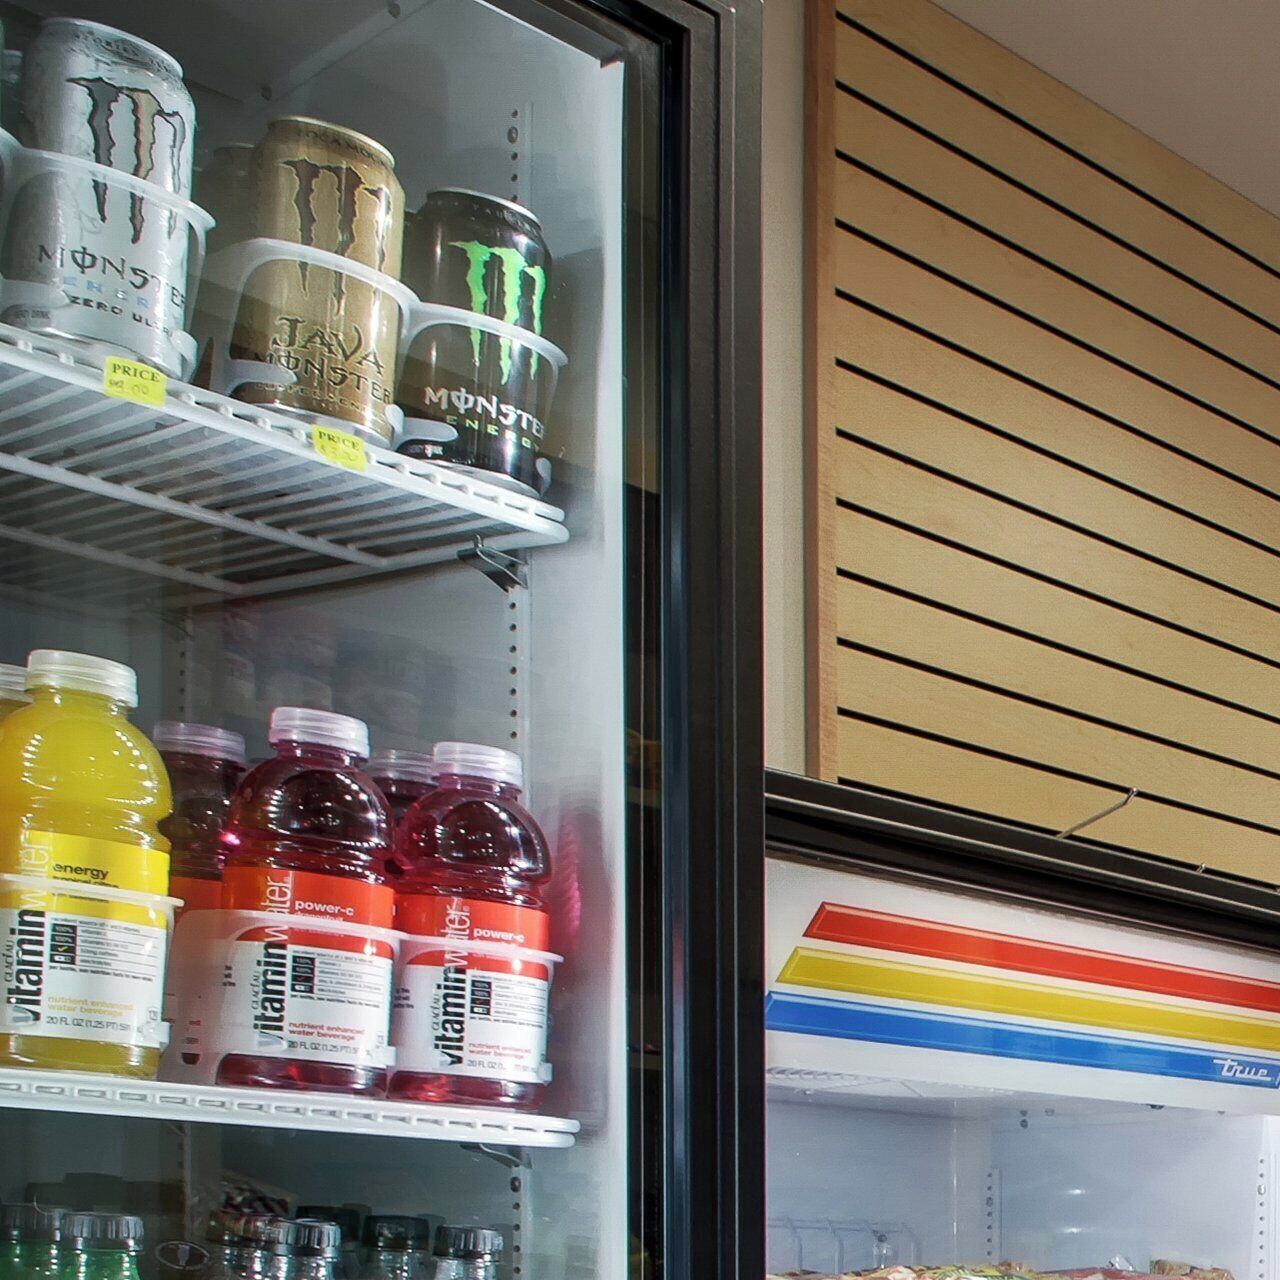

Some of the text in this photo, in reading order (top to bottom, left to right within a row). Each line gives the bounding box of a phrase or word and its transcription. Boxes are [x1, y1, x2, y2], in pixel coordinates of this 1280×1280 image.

[70, 295, 123, 316] ZERO
[271, 316, 384, 377] JAVA
[111, 362, 161, 384] PRICE
[318, 429, 360, 448] PRICE
[53, 862, 110, 880] energy
[294, 900, 355, 917] power-c
[473, 927, 525, 943] power-c
